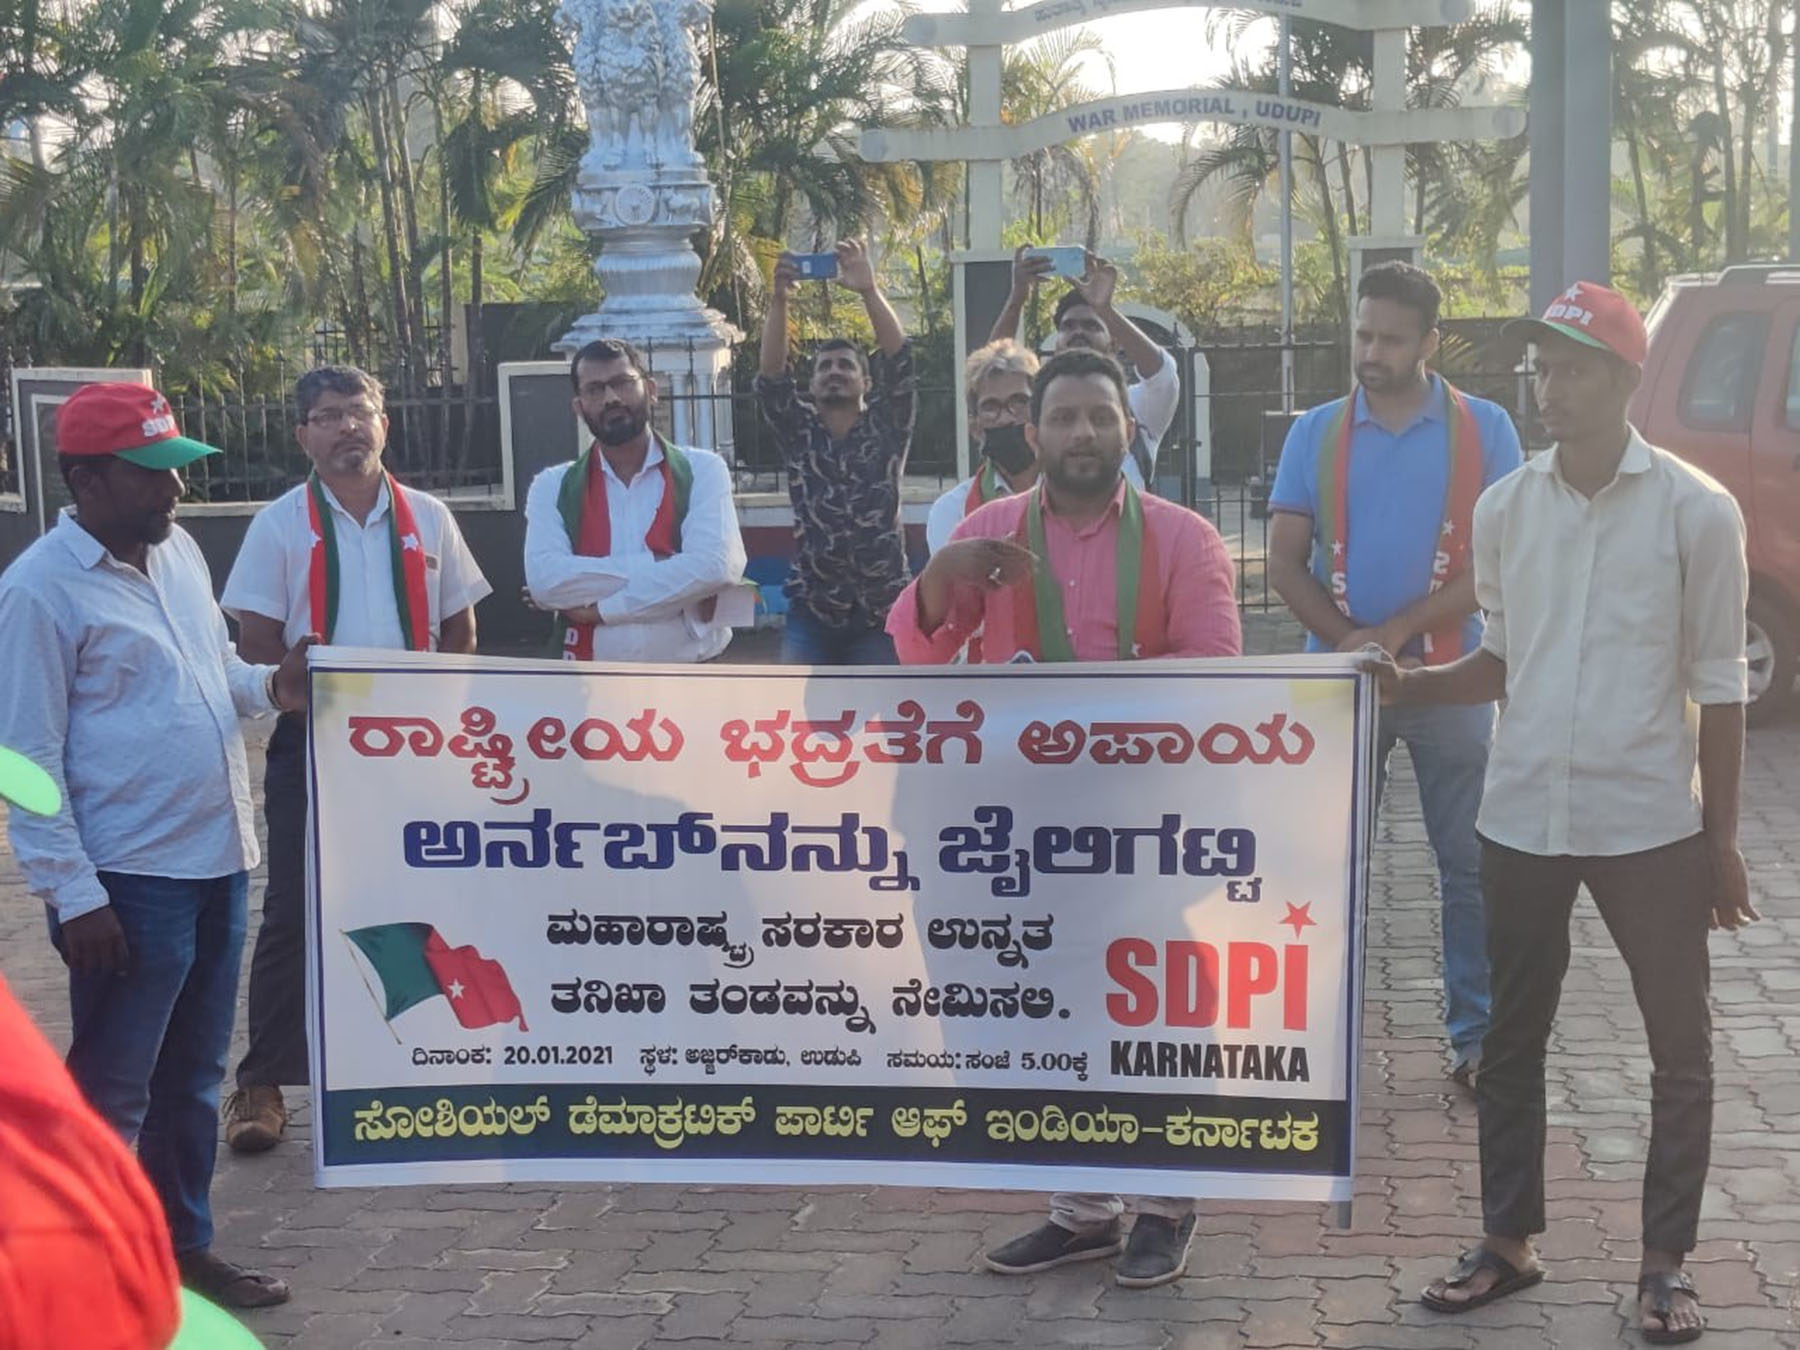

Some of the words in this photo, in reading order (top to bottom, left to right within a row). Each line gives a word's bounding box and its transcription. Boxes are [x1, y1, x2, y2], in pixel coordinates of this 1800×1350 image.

[1067, 109, 1117, 134] WAR
[1255, 101, 1322, 127] UDUPI
[348, 705, 685, 806] ರಾಷ್ಟ್ರೀಯ
[719, 698, 986, 788] ಭದ್ರತೆಗೆ
[1016, 713, 1316, 765] ಅಪಾಯ
[938, 805, 1263, 903] ಜೈಲಿಗಟ್ಟಿ
[546, 908, 755, 969] ಮಹಾರಾಷ್ಟ್ರ
[761, 911, 905, 950] ಸರಕಾರ
[926, 913, 1054, 969] ಉನ್ನತ
[550, 977, 667, 1015] ತನಿಖಾ
[689, 978, 877, 1034] ತಂಡವನ್ನು
[892, 979, 1071, 1020] ನೇಮಿಸಲಿ.
[1105, 936, 1310, 1032] SDPI
[411, 1045, 492, 1066] ದಿನಾಂಕ:
[503, 1045, 614, 1066] 20.01.2021
[800, 1046, 863, 1067] ಉಡುಪಿ
[1110, 1040, 1310, 1082] KARNATAKA
[353, 1094, 551, 1142] ಸೋಶಿಯಲ್
[568, 1094, 756, 1149] ಡೆಮಾಕ್ರಟಿಕ್
[775, 1105, 874, 1138] ಪಾರ್ಟಿ
